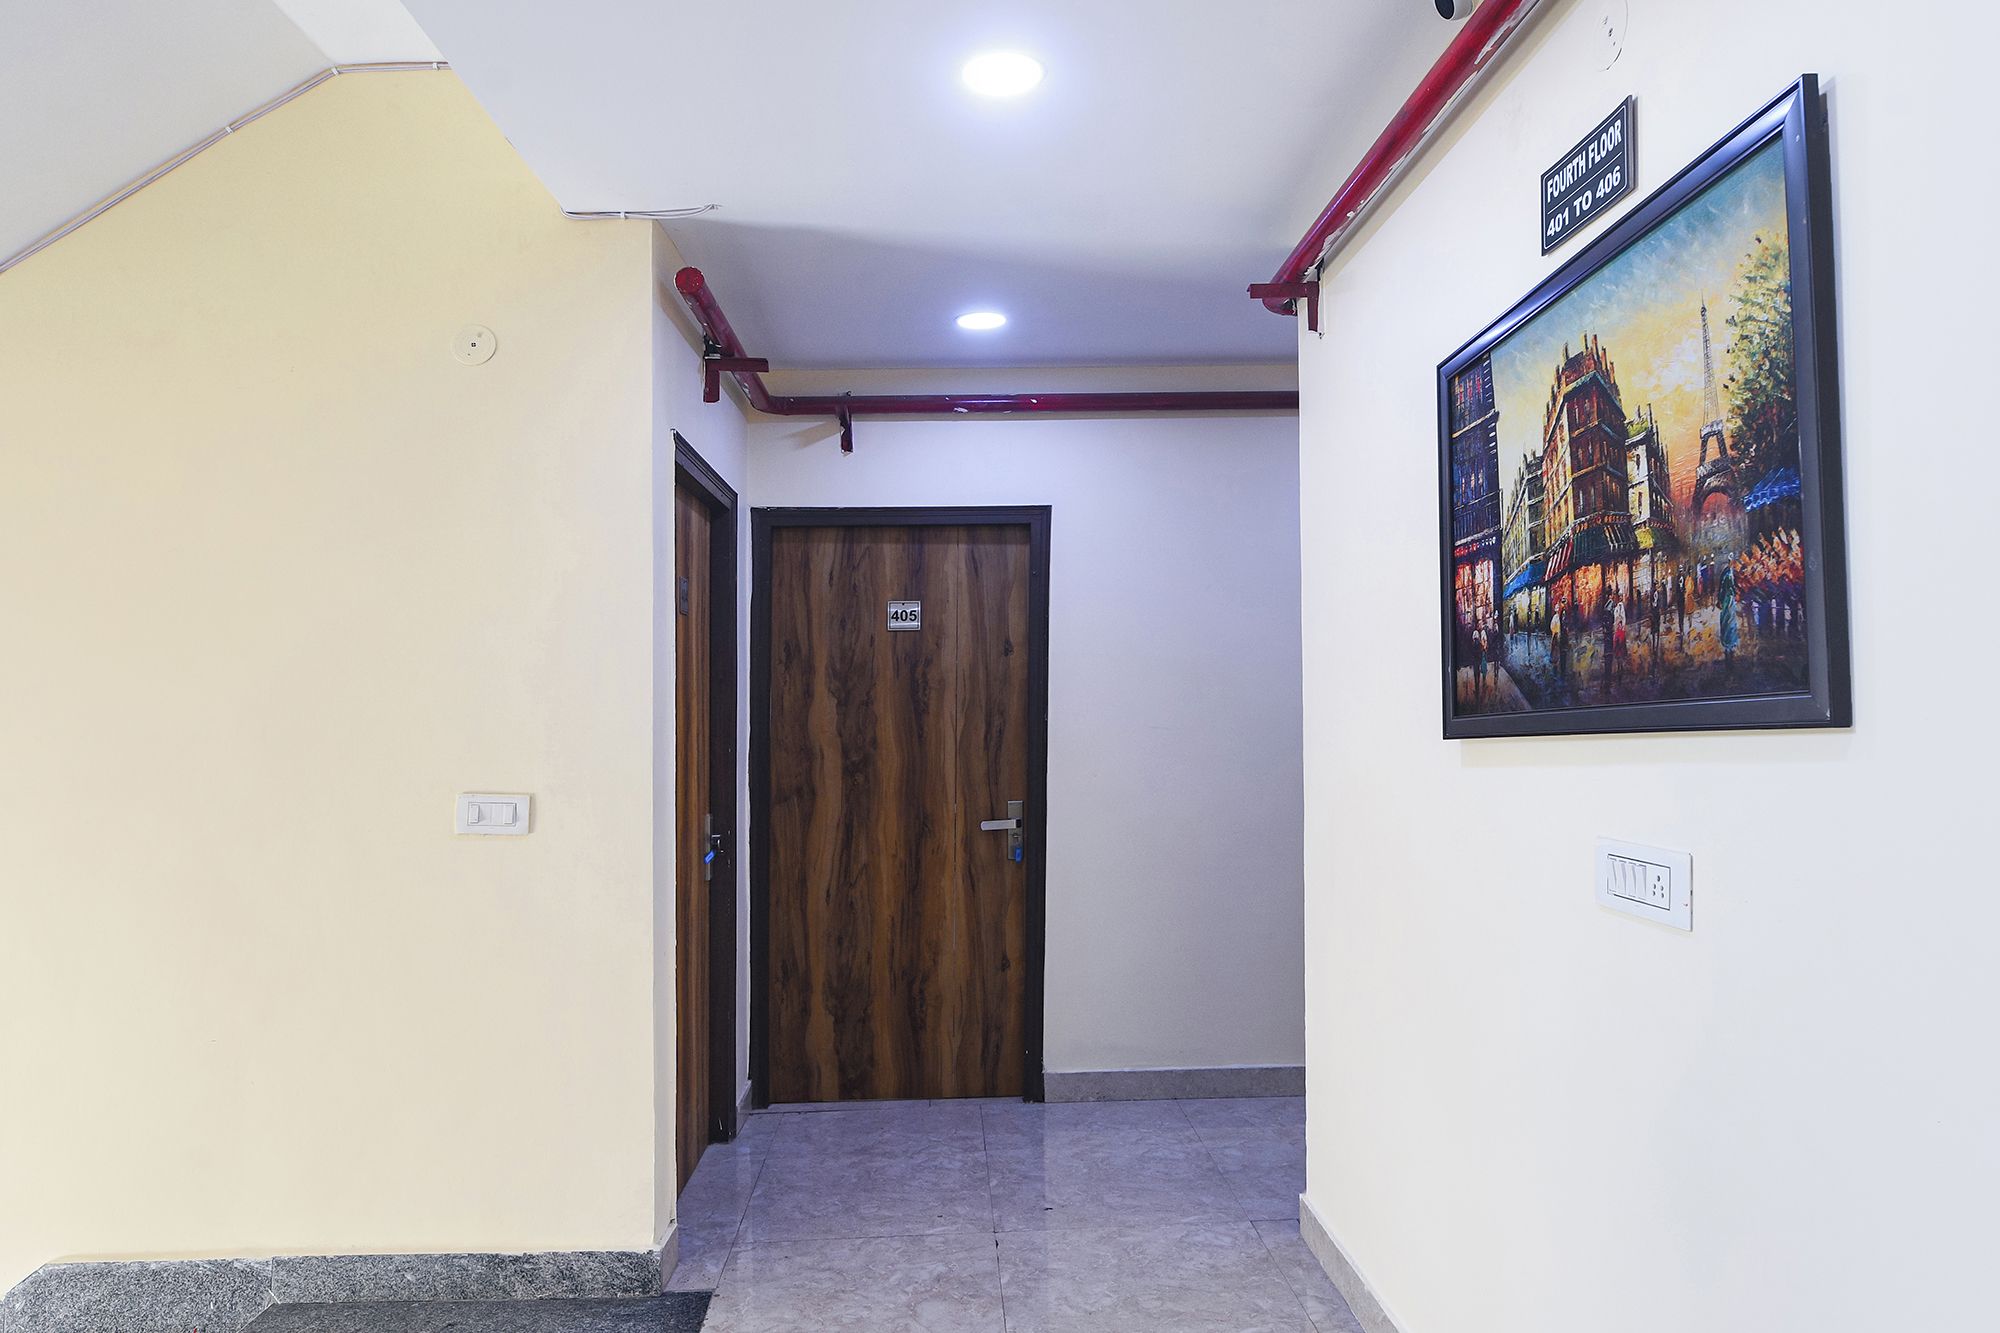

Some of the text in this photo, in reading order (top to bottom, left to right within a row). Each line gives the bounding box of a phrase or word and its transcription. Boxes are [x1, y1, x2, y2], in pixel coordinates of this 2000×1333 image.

[1547, 119, 1622, 203] FOURTH FLOOR
[1546, 165, 1621, 237] 401 TO 406
[891, 610, 917, 621] 405
